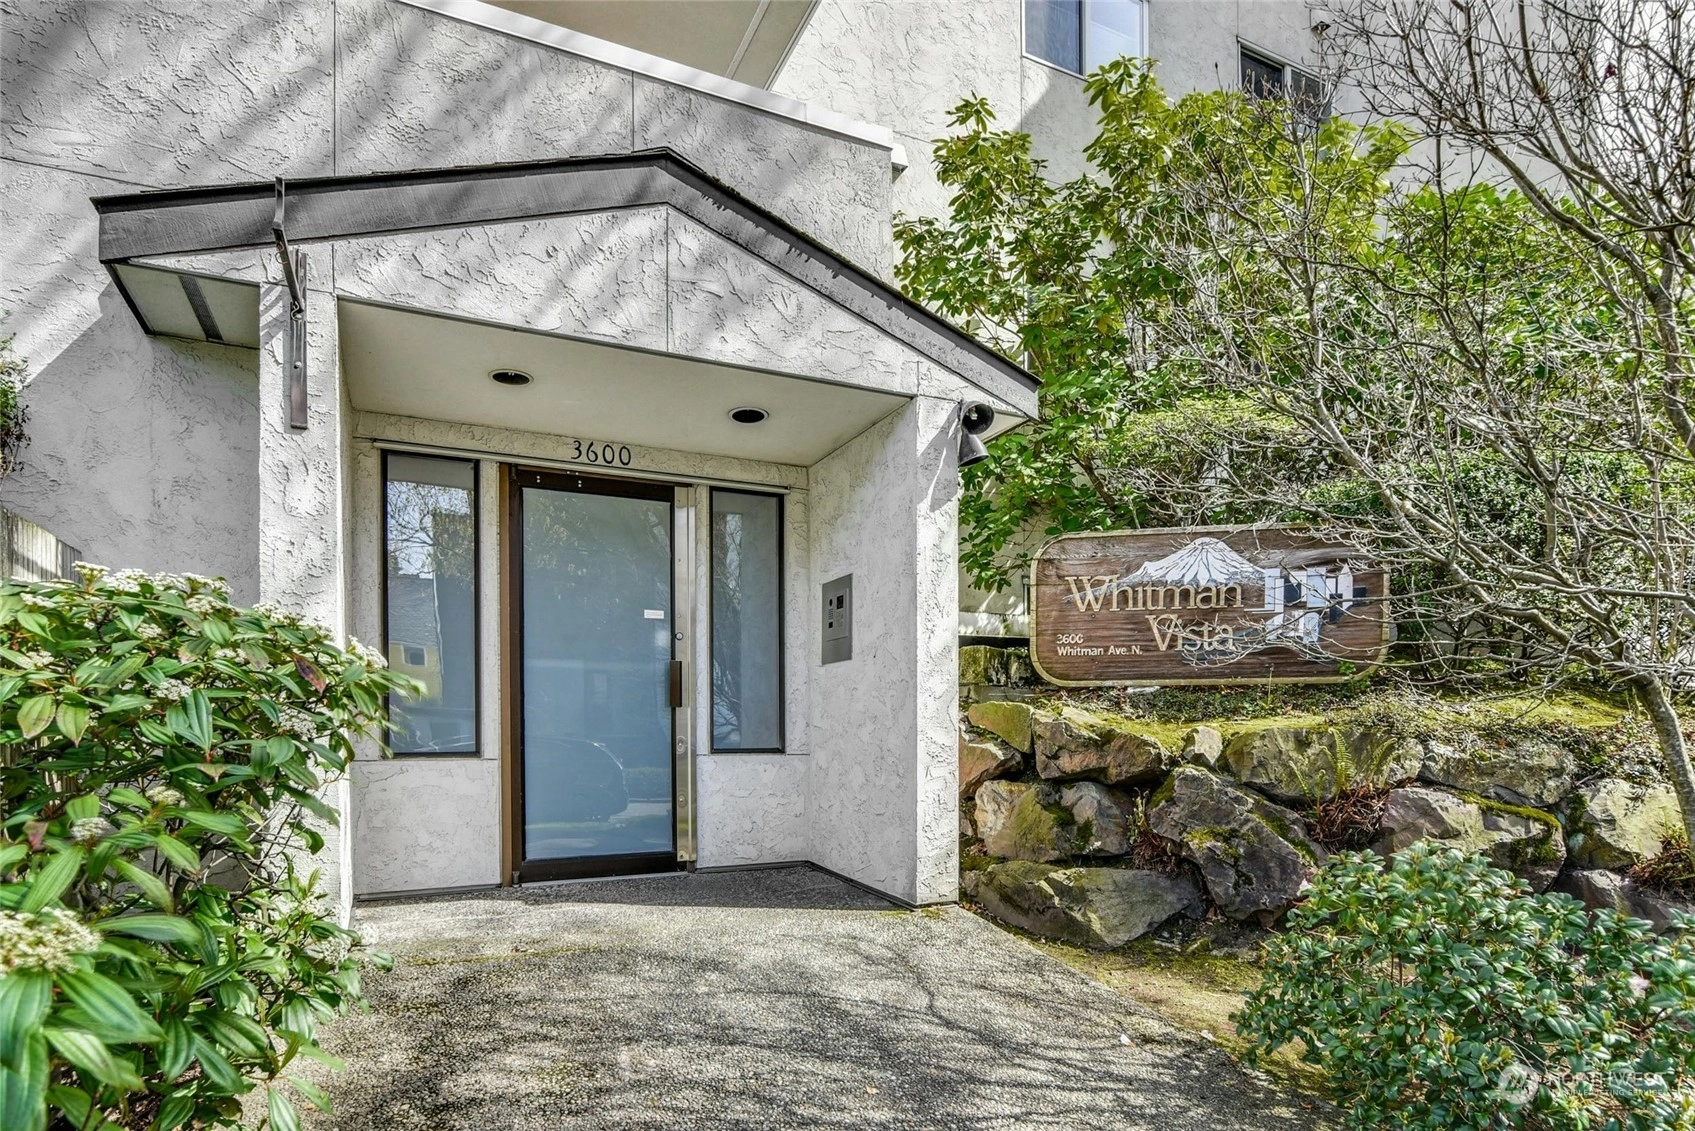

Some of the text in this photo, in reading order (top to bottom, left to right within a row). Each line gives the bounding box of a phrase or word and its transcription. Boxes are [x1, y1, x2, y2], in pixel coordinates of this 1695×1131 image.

[571, 440, 631, 466] 3600
[1065, 574, 1244, 612] Whitman
[1145, 613, 1234, 651] Vista
[1057, 645, 1143, 656] Whitman Ave. N.
